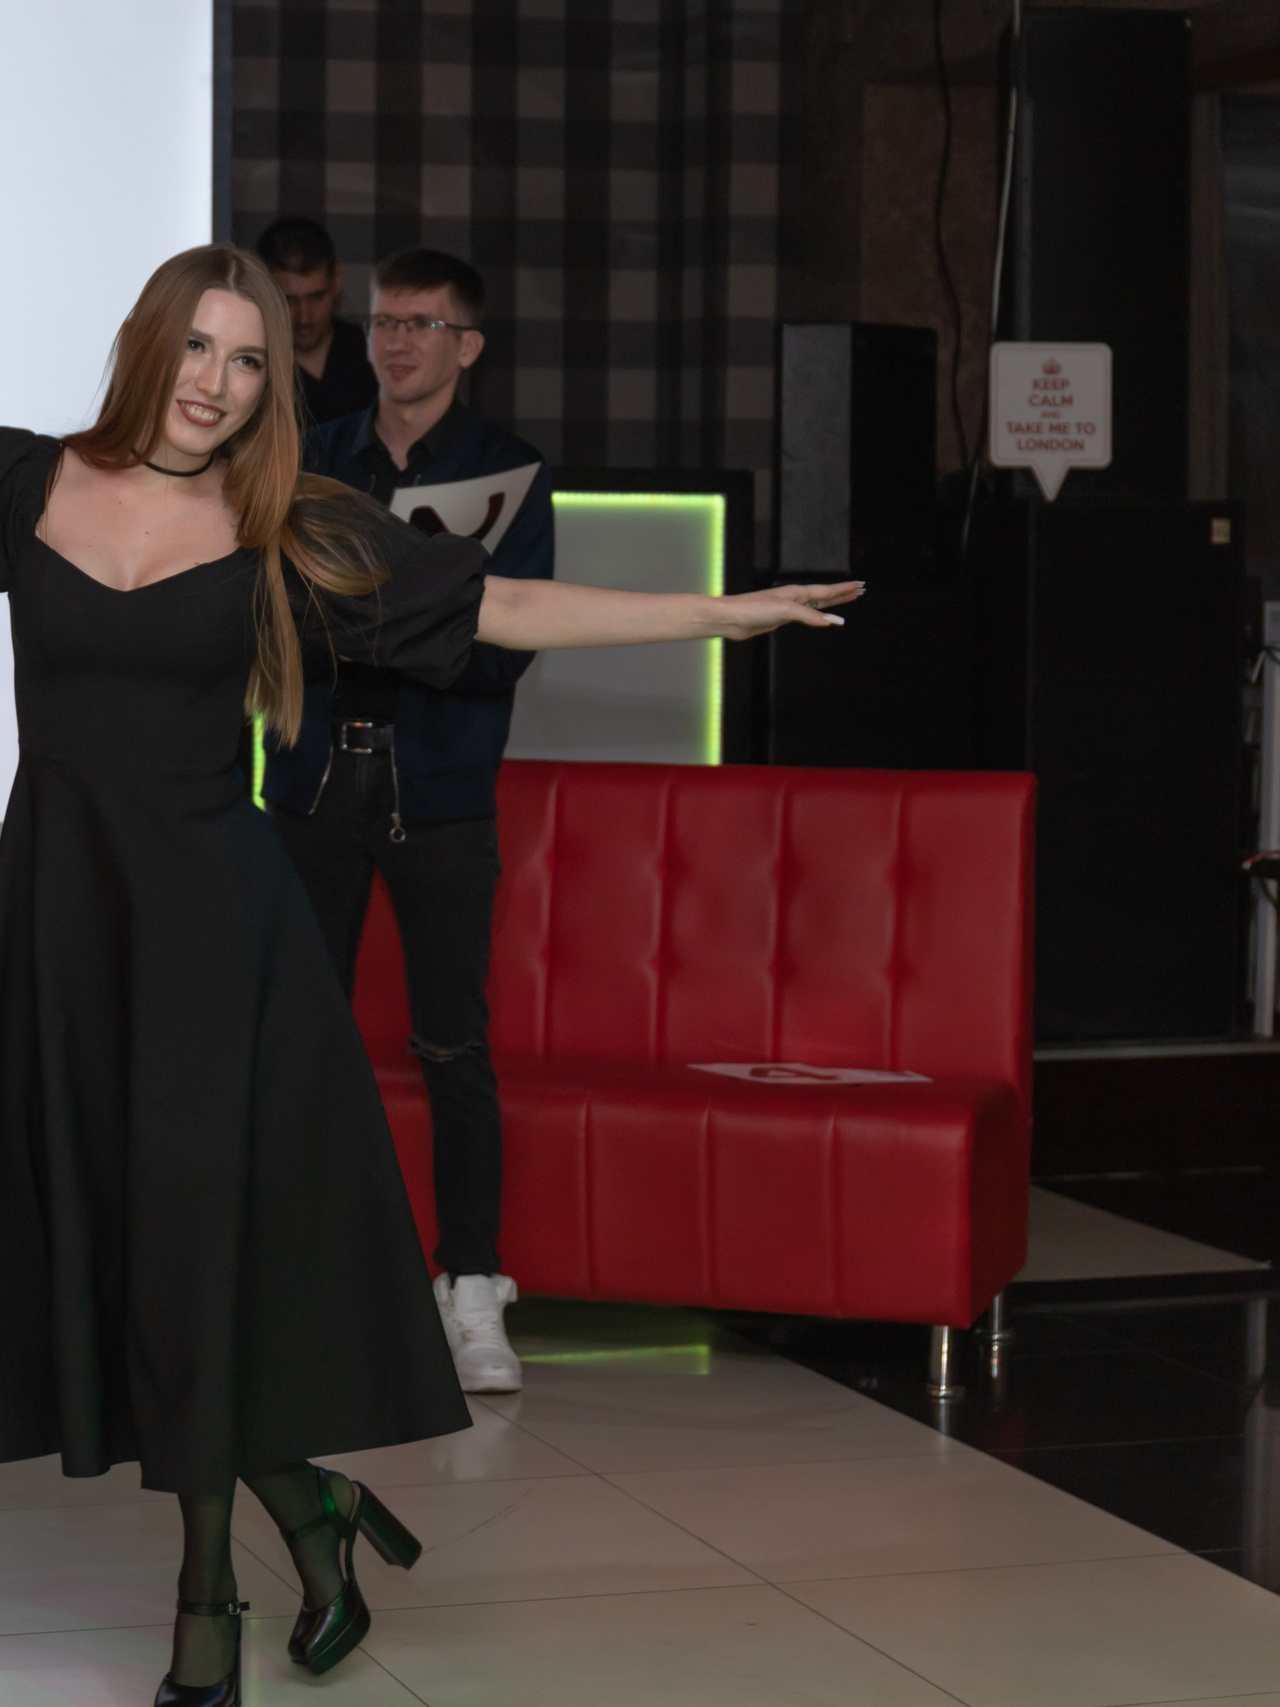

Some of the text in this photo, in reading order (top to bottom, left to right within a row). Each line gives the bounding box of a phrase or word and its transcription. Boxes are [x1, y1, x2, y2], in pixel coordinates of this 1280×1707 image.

[1033, 379, 1070, 390] KEEP
[1028, 394, 1074, 407] CALM
[1006, 422, 1096, 435] TAKE ME TO
[1017, 439, 1085, 451] LONDON
